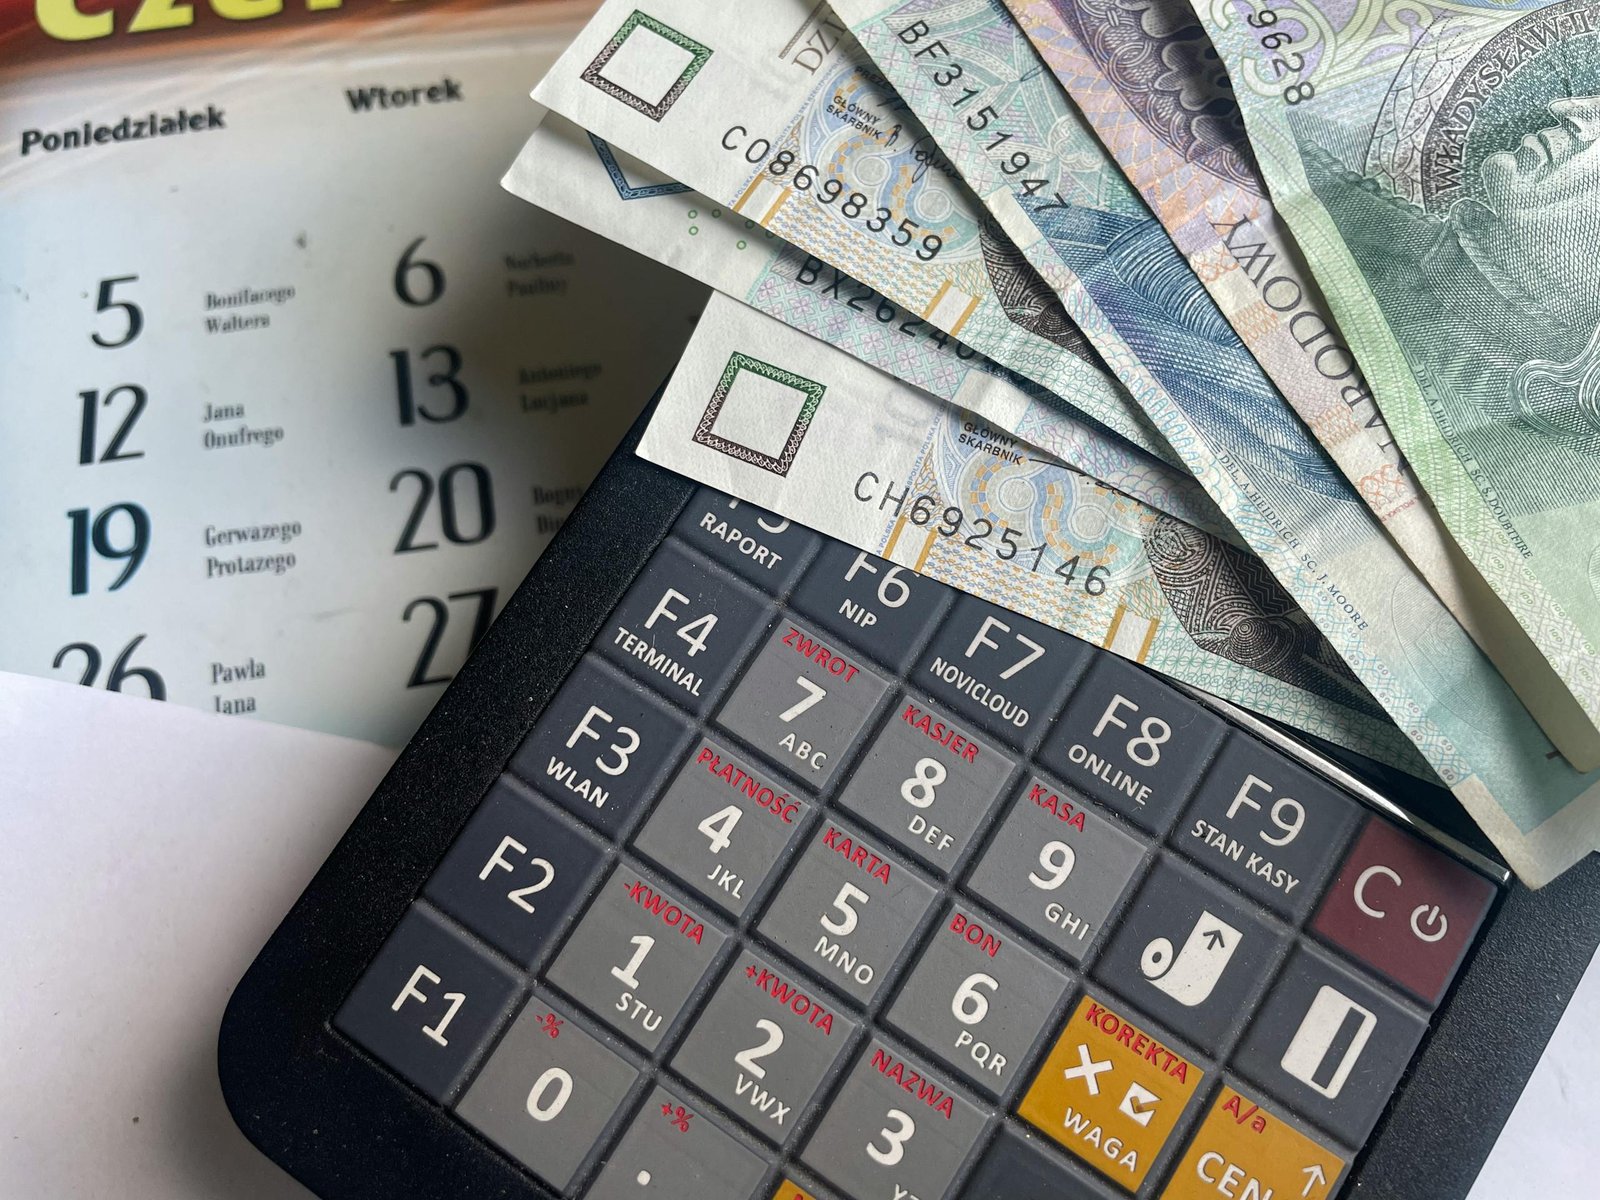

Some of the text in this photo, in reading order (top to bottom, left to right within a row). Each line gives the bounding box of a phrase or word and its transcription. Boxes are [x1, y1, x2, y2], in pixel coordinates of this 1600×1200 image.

[1246, 9, 1316, 106] 9628
[20, 77, 465, 155] Poniedziałek Wtorek
[826, 105, 882, 140] SKARBNIK
[833, 95, 881, 126] GŁÓWNY
[897, 20, 1071, 214] BF3151947
[1433, 14, 1565, 194] WŁADYSŁAW
[204, 284, 296, 310] Bonifacego
[394, 236, 446, 308] 6
[91, 274, 145, 349] 5
[205, 313, 270, 334] Waltera
[203, 402, 245, 423] Jana
[389, 344, 471, 427] 13
[77, 383, 149, 466] 12
[204, 424, 285, 449] Onufrego
[958, 433, 1023, 466] SKARBNIK
[963, 421, 1019, 449] GŁÓWNY
[1218, 452, 1240, 483] DEL.
[205, 521, 302, 548] Gerwazego
[389, 461, 497, 555] 20
[853, 472, 1110, 597] CH6925146
[67, 502, 152, 595] 19
[207, 552, 297, 579] Protazego
[700, 512, 783, 570] RAPORT
[844, 551, 921, 608] F6
[401, 586, 499, 690] 27
[644, 587, 720, 658] F4
[838, 599, 878, 628] NIP
[52, 634, 167, 701] 26
[614, 626, 705, 697] TERMINAL
[780, 627, 860, 683] ZWROT
[965, 615, 1046, 680] F7
[778, 675, 827, 722] 7
[930, 657, 1030, 728] NOVICLOUD
[565, 704, 642, 776] F3
[778, 732, 829, 770] ABC
[902, 704, 980, 764] KASJER
[1092, 694, 1172, 767] F8
[547, 755, 610, 809] WLAN
[697, 747, 801, 825] PŁATNOŚĆ
[900, 757, 947, 808] 8
[1068, 744, 1153, 807] ONLINE
[698, 804, 744, 854] 4
[907, 813, 956, 853] DEF
[1028, 783, 1087, 832] KASA
[1225, 773, 1306, 848] F9
[478, 835, 556, 915] F2
[707, 864, 743, 900] JKL
[822, 826, 892, 886] KARTA
[1028, 840, 1076, 891] 9
[1190, 819, 1301, 895] STAN KASY
[819, 882, 870, 936] 5
[1352, 864, 1402, 919] C
[949, 912, 1002, 958] BON
[1044, 901, 1090, 941] GHI
[610, 934, 656, 991] 1
[814, 935, 874, 986] MNO
[391, 964, 467, 1048] F1
[615, 992, 663, 1033] STU
[745, 964, 835, 1036] +KWOTA
[951, 972, 1000, 1025] 6
[734, 1018, 785, 1080] 2
[955, 1029, 1007, 1077] PQR
[1085, 1003, 1188, 1085] KOREKTA
[525, 1066, 575, 1123] 0
[735, 1073, 791, 1127] VWX
[870, 1048, 955, 1120] NAZWA
[865, 1109, 916, 1166] 3
[1063, 1106, 1139, 1173] WAGA
[1221, 1095, 1267, 1134] A/a
